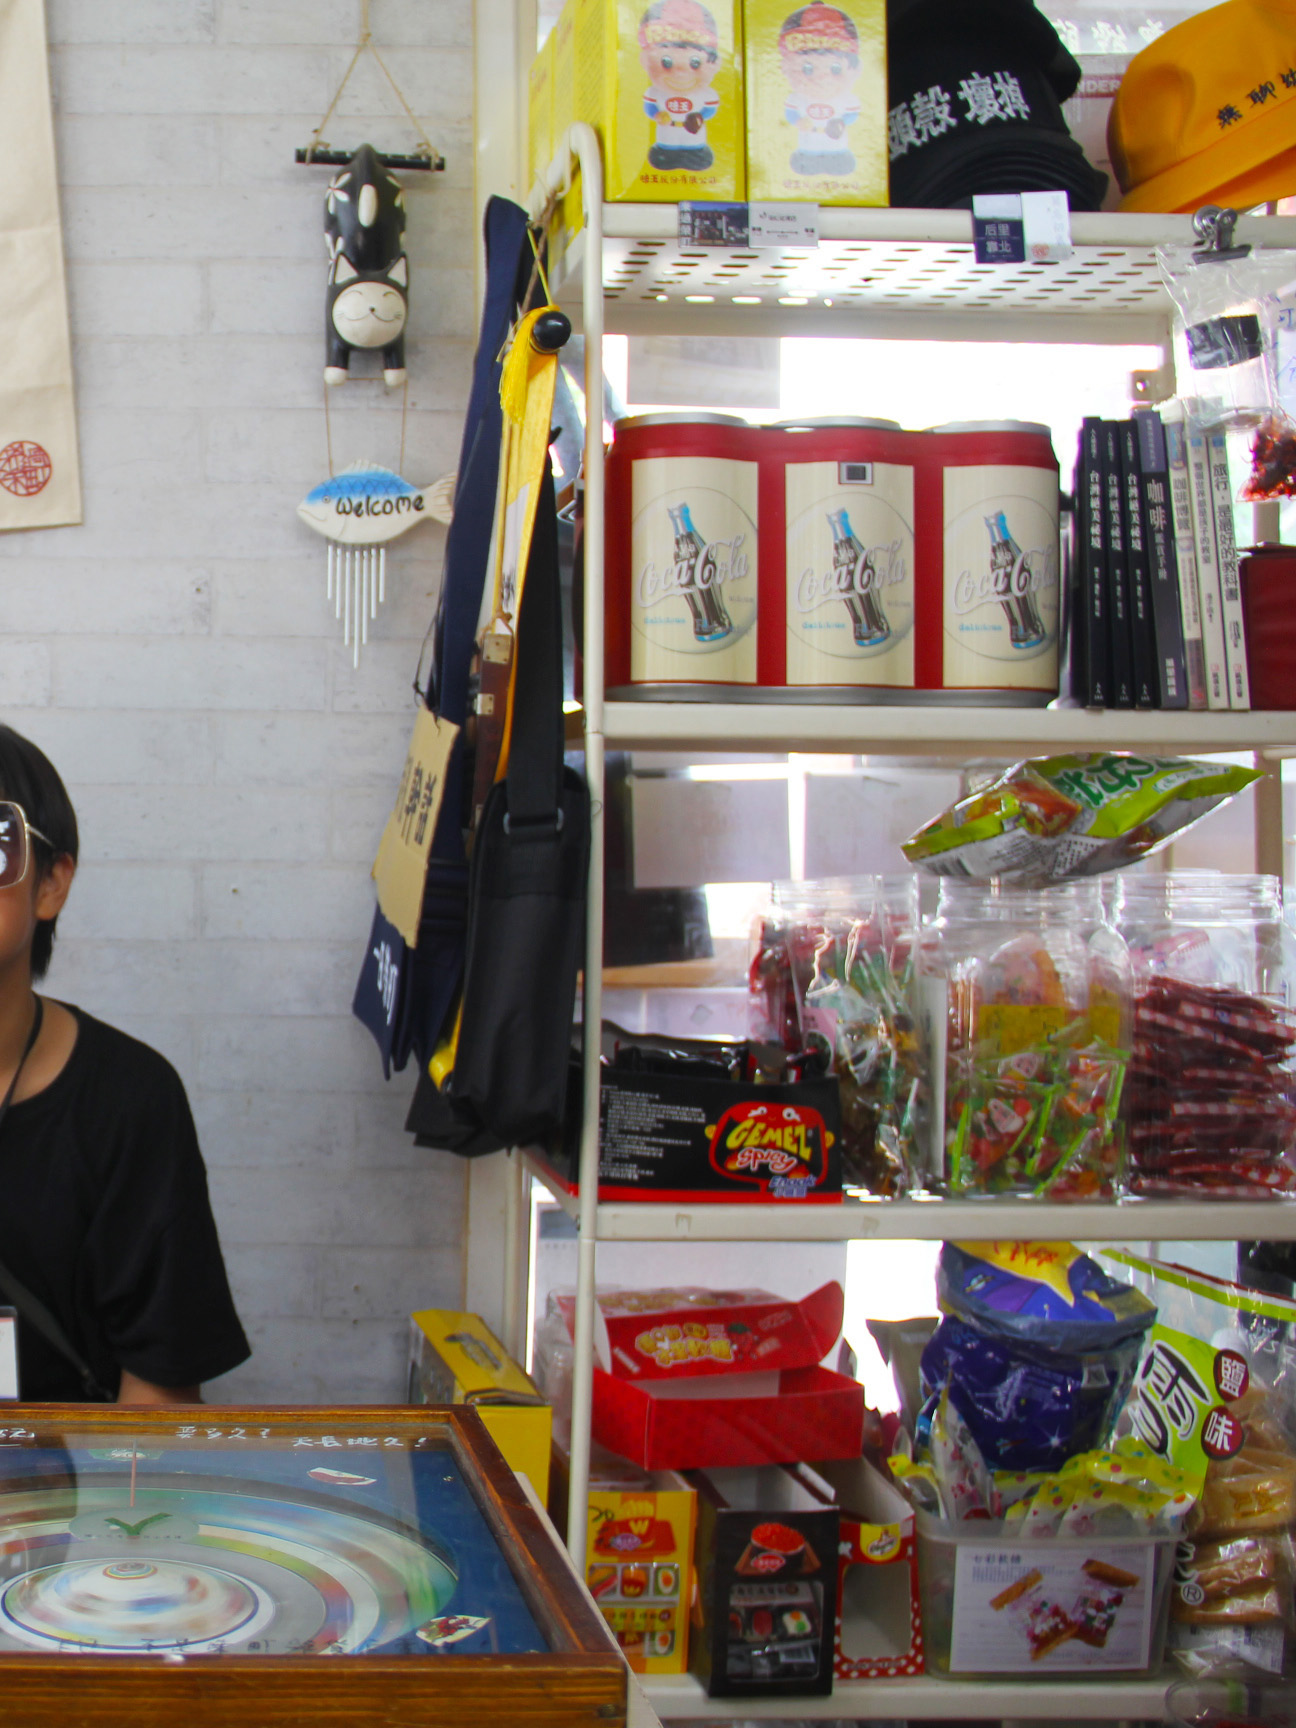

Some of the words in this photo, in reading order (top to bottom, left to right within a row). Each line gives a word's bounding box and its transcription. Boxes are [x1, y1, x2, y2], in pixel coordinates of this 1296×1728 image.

[336, 495, 425, 518] Welcome
[637, 534, 748, 607] Coca-Cola
[797, 538, 906, 613] Coca-Cola
[726, 1118, 812, 1161] GEMEZ
